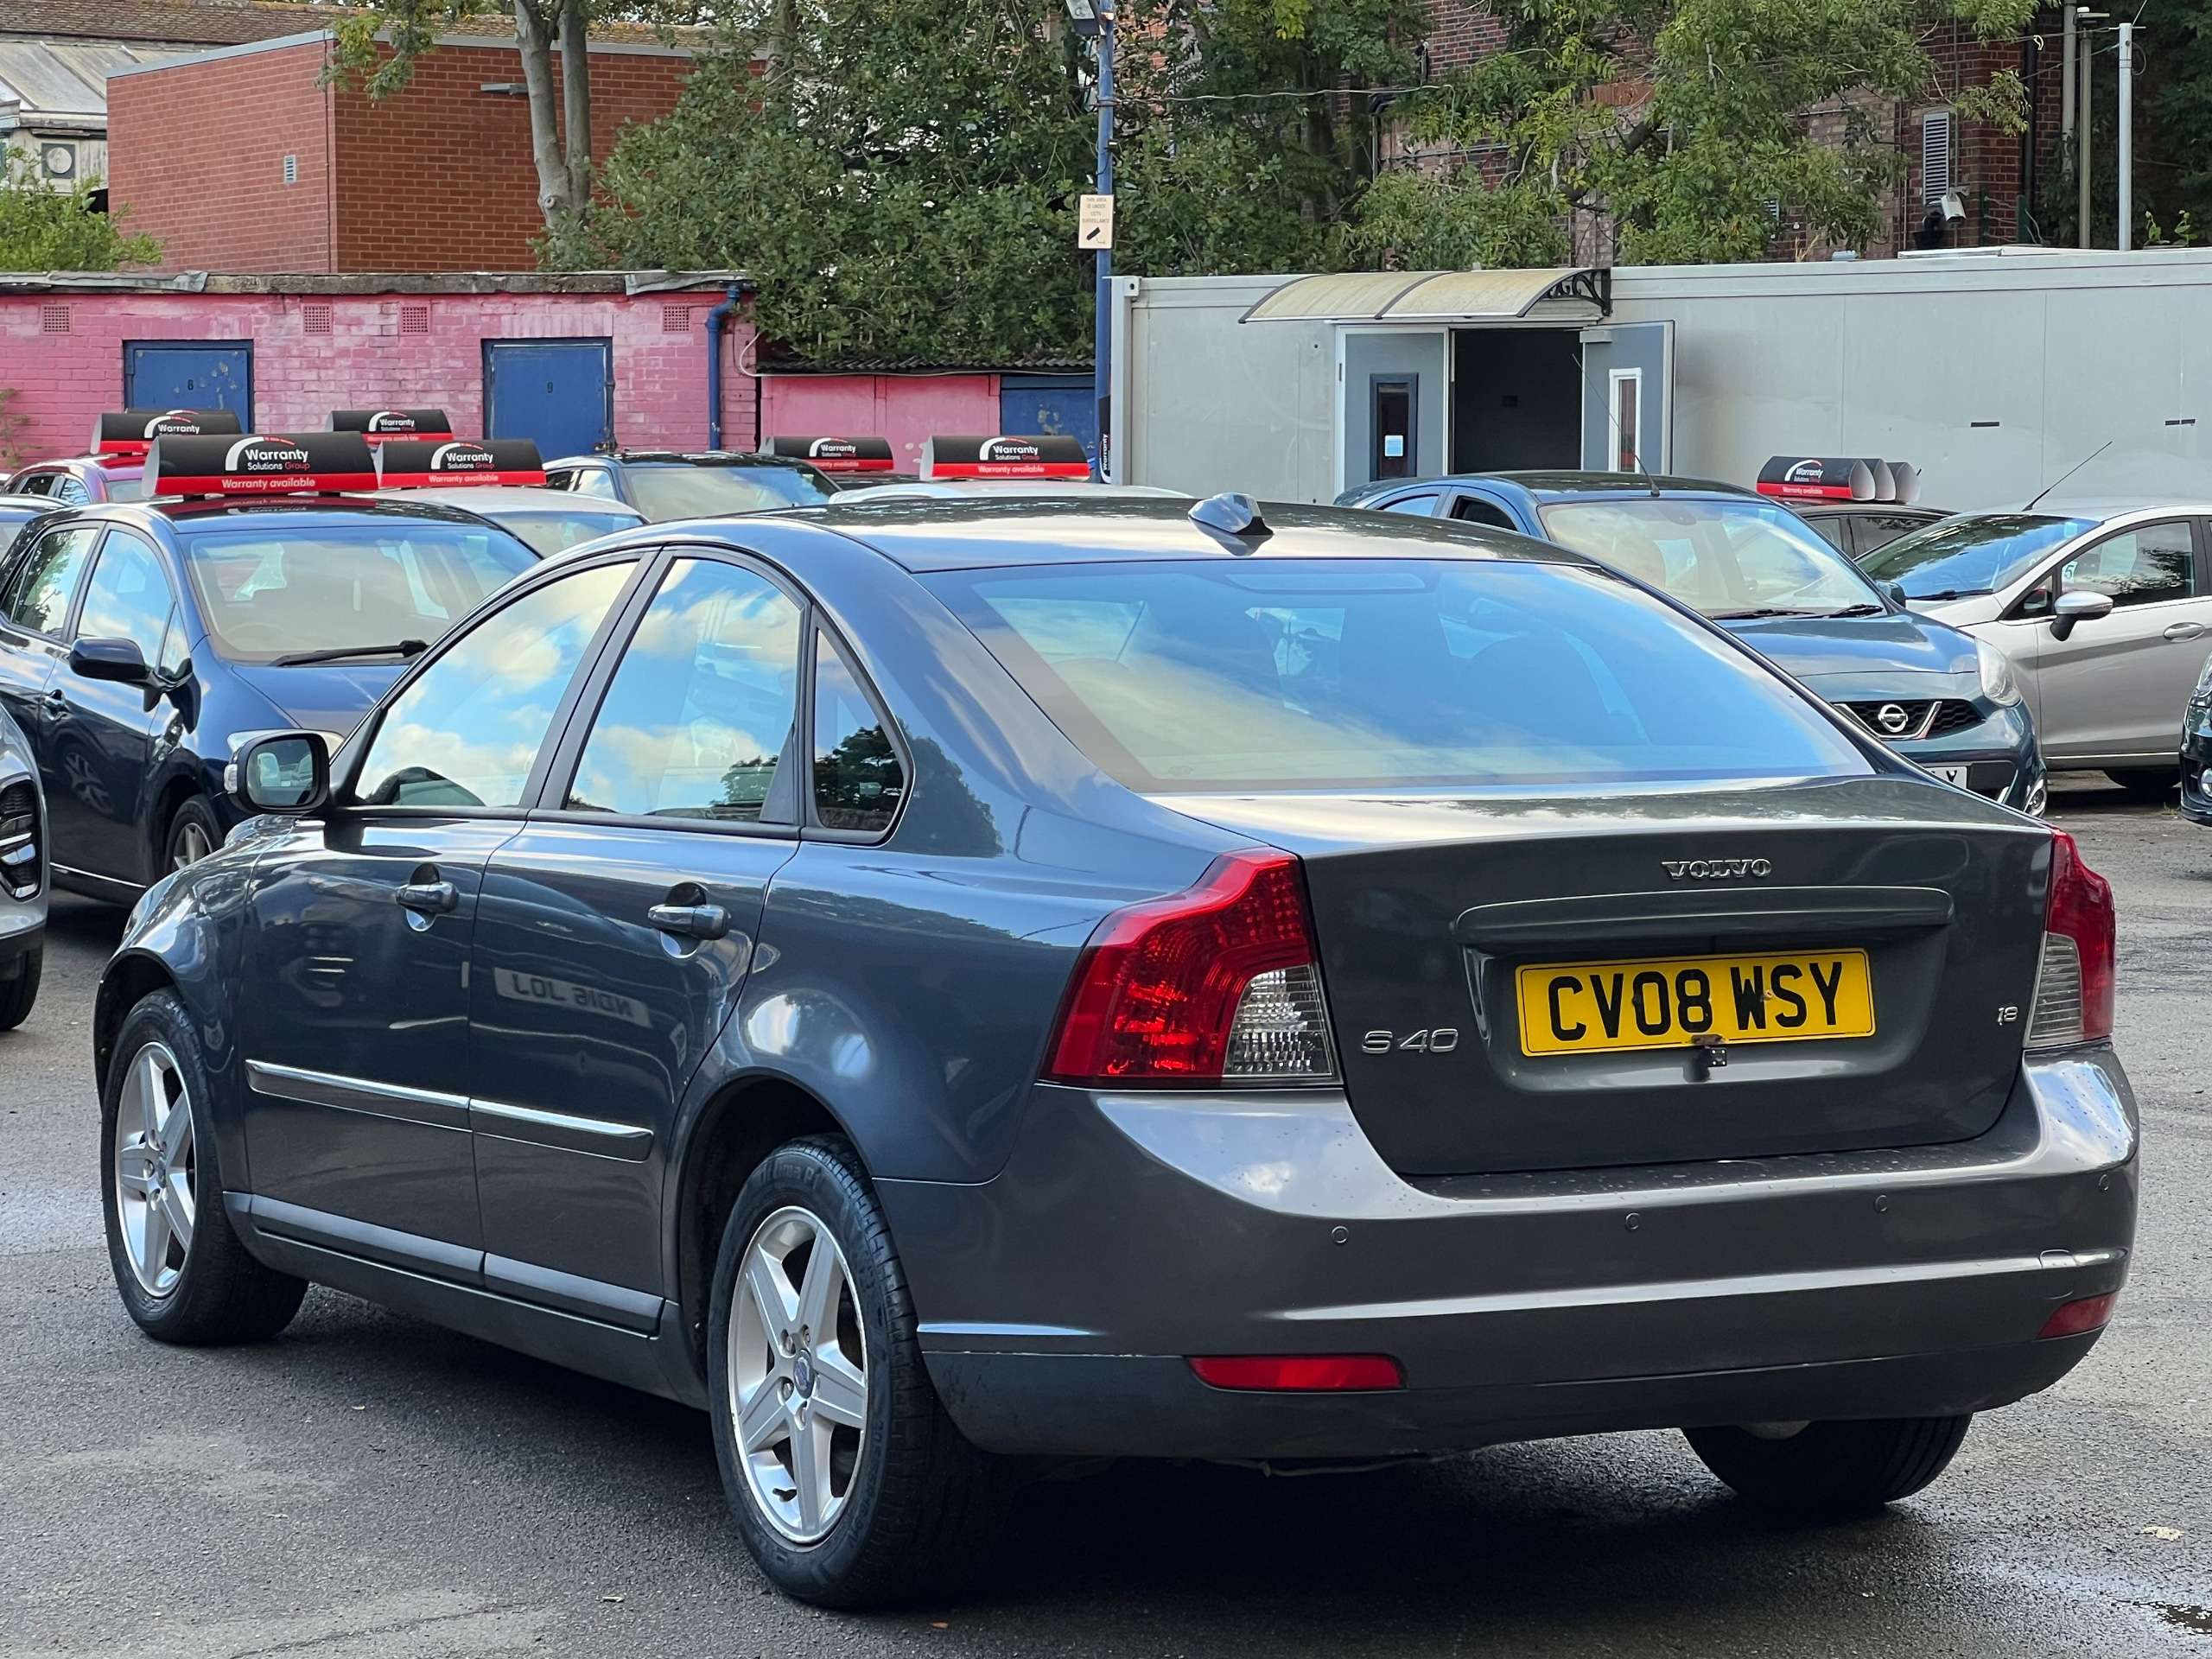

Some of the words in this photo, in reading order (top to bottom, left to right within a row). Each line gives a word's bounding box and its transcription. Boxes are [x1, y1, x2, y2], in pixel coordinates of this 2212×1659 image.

[187, 379, 194, 391] 8
[547, 381, 554, 393] 9
[379, 418, 415, 427] Warranty
[157, 423, 200, 435] Warranty
[820, 444, 856, 453] Warranty
[993, 445, 1039, 455] Warranty
[245, 448, 308, 462] Warranty
[446, 452, 493, 463] Warranty
[247, 461, 283, 470] Solutions
[284, 461, 310, 471] Group
[977, 465, 1011, 474] Warranty
[429, 474, 463, 484] Warranty
[464, 474, 499, 482] available
[1796, 467, 1824, 479] Warranty
[221, 479, 268, 490] Warranty
[270, 477, 315, 487] available
[1662, 858, 1772, 880] VOLVO
[1548, 968, 1713, 1042] CV08
[1731, 961, 1843, 1030] WSY
